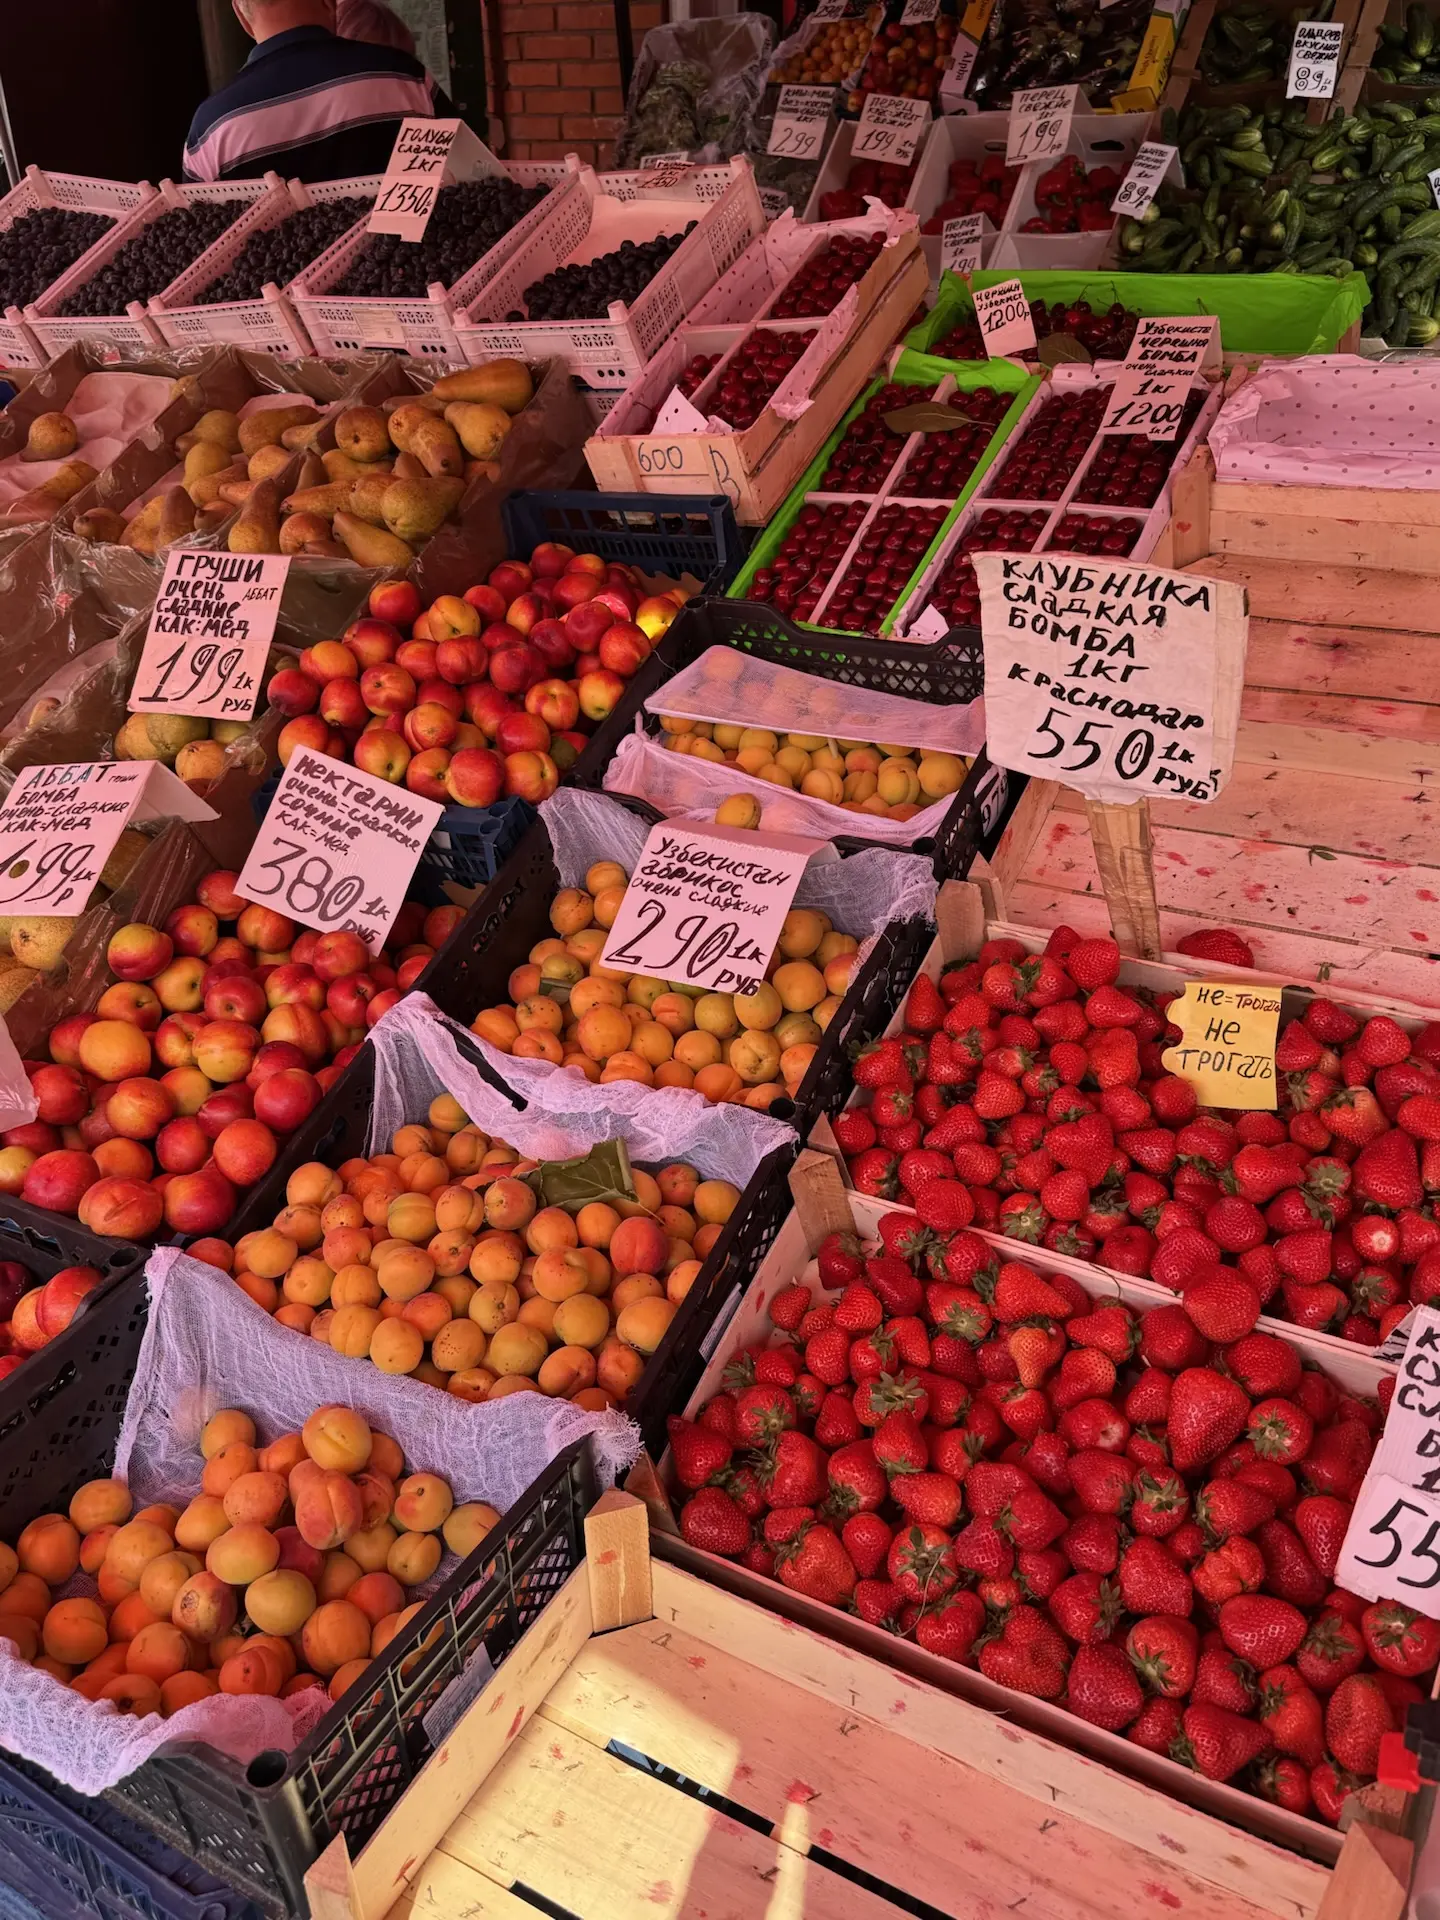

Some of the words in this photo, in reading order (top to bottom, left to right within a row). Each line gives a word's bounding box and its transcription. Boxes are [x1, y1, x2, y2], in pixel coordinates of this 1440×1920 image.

[956, 51, 974, 80] Alpha
[1294, 66, 1325, 91] 89
[772, 127, 817, 155] 299
[855, 129, 897, 152] 199
[1007, 119, 1063, 162] 199
[402, 155, 442, 172] 1кг
[374, 182, 434, 213] 1350
[1118, 182, 1149, 204] 89
[1132, 378, 1176, 397] 1кг
[1103, 401, 1184, 429] 1200
[638, 442, 683, 472] 600
[175, 554, 265, 584] ГРУШИ
[242, 587, 278, 602] АББАТ
[1001, 558, 1211, 613] КЛУБНИКА
[1007, 605, 1136, 659] БОМБА
[138, 641, 245, 704] 199
[1026, 706, 1155, 781] 550
[22, 763, 117, 791] АББАТ
[15, 786, 81, 807] БОМБА
[245, 836, 366, 923] 380
[630, 877, 682, 898] очень
[603, 898, 741, 979] 290
